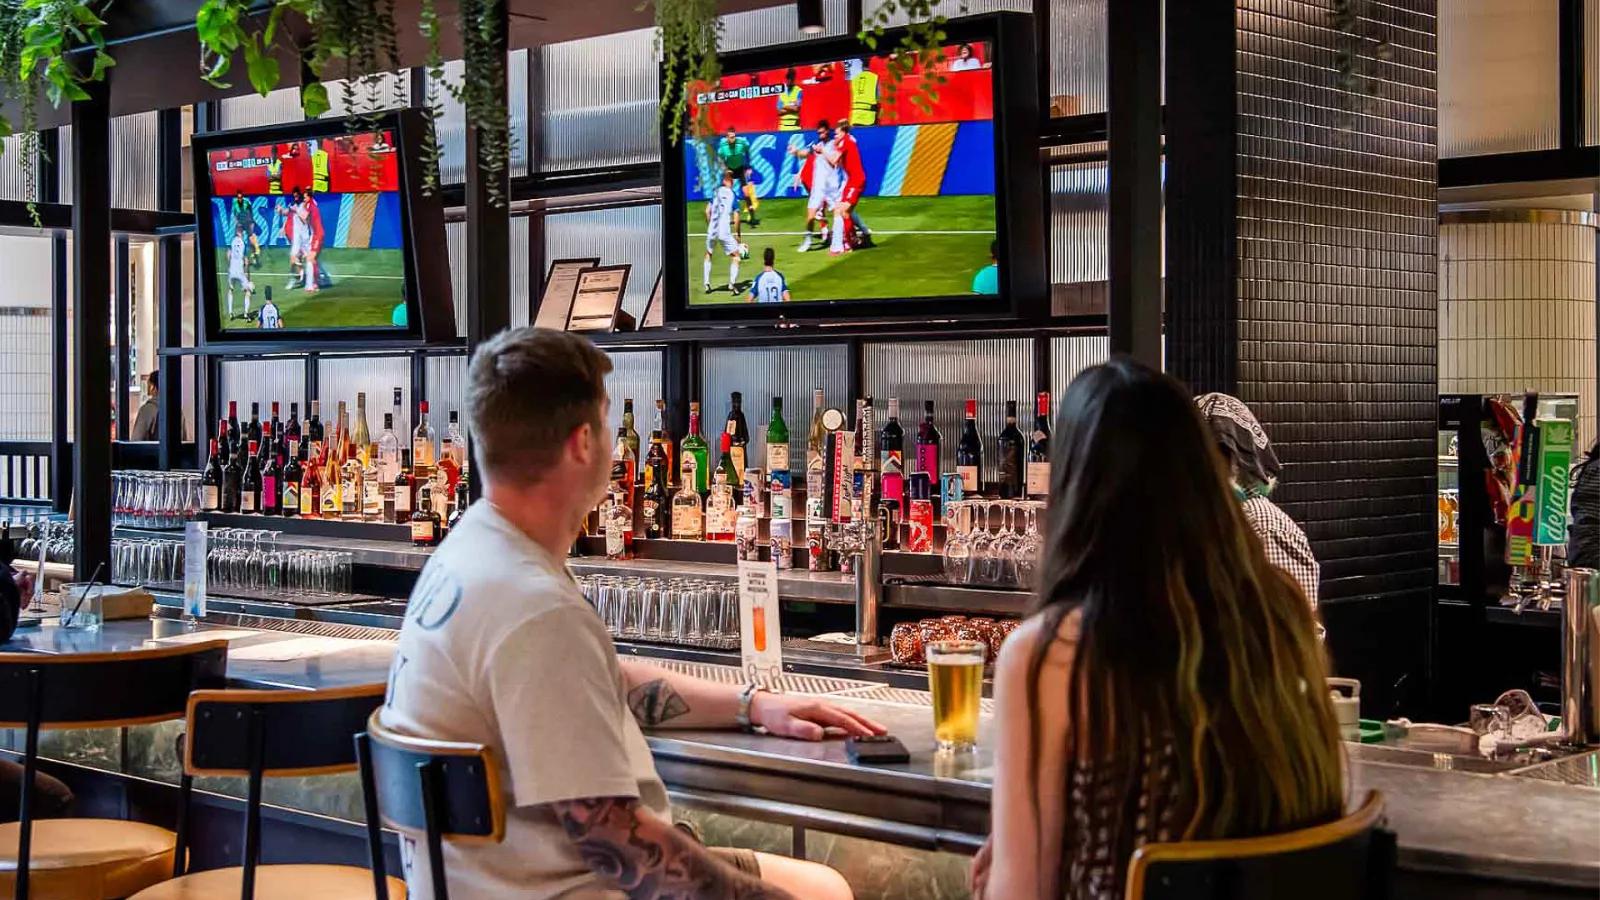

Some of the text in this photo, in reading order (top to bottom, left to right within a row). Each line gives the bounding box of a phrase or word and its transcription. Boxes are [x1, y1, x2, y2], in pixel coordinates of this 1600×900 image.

[684, 133, 811, 199] VSA
[211, 196, 292, 246] VSA
[1541, 465, 1567, 542] dejado
